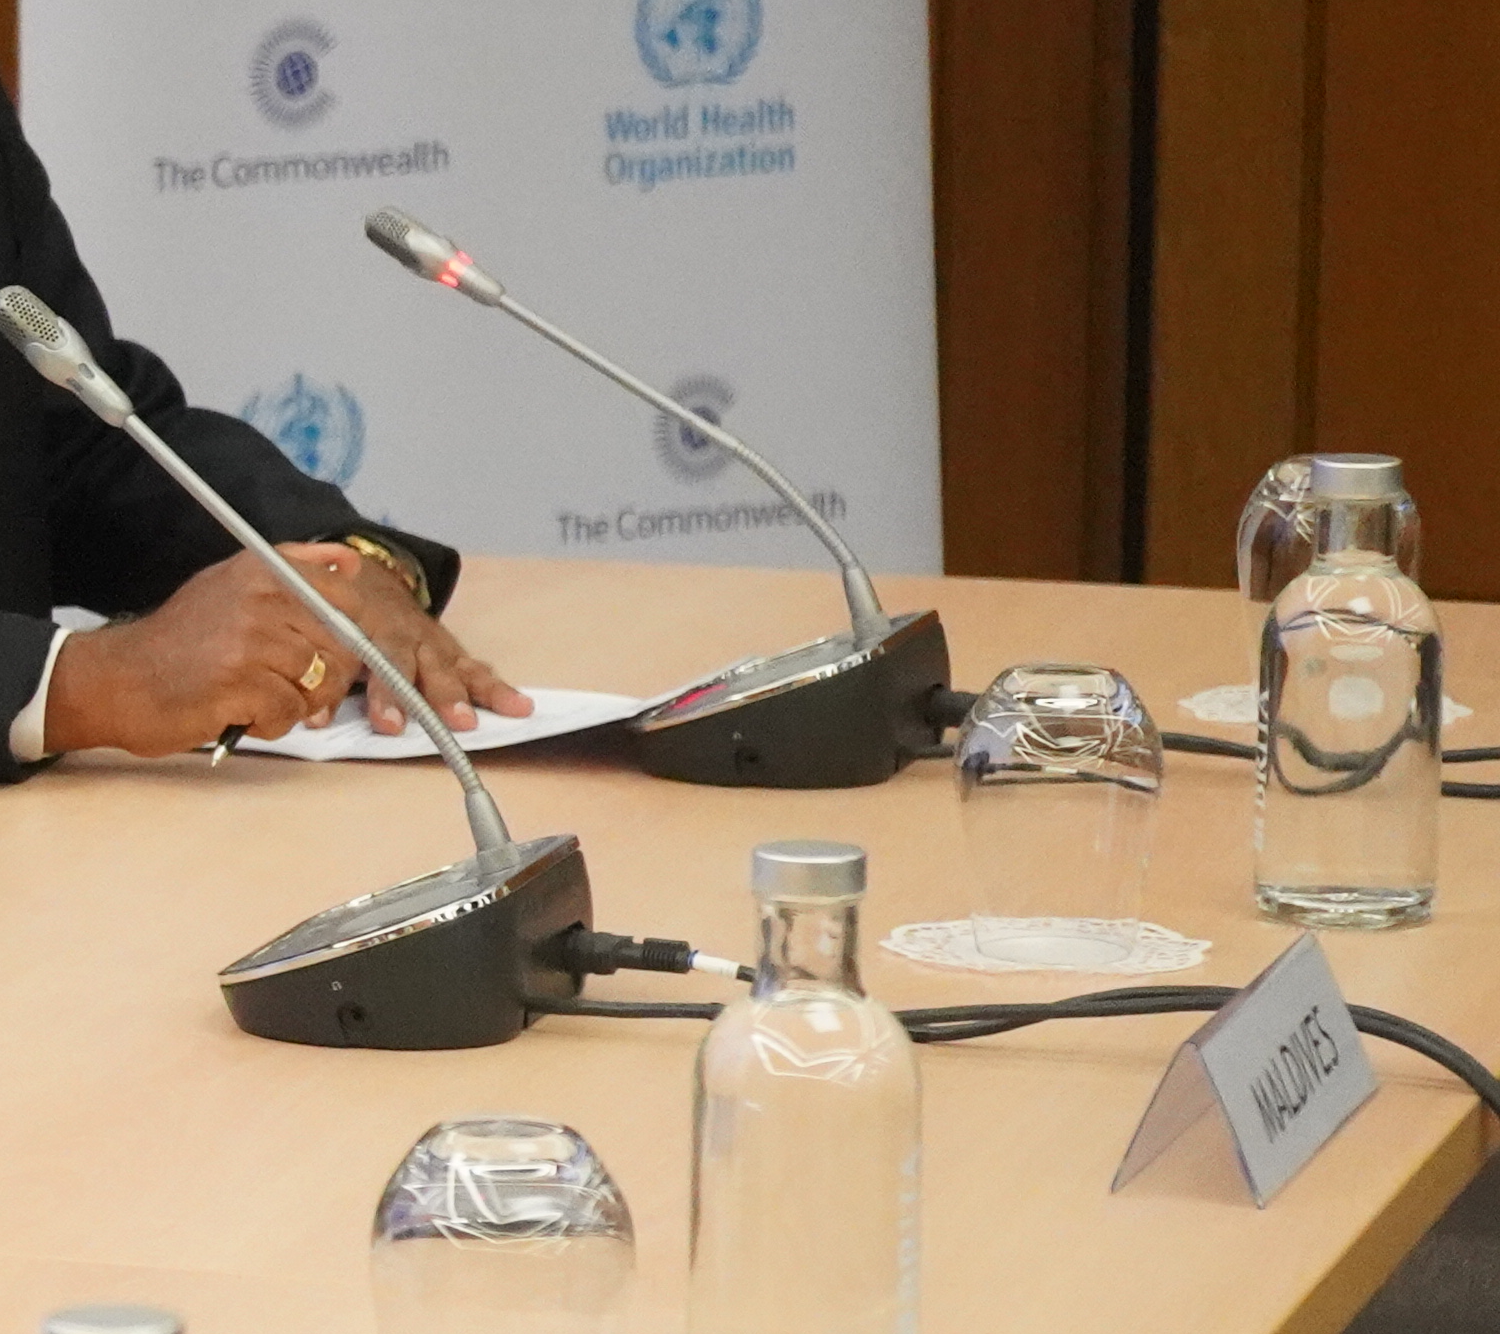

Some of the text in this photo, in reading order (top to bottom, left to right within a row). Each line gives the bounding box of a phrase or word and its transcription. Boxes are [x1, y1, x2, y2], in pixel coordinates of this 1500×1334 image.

[605, 96, 795, 142] World Health
[153, 140, 450, 193] The Commonwealth
[605, 147, 795, 193] Organization
[557, 512, 609, 545] The
[1249, 1004, 1340, 1145] MALDIVES
